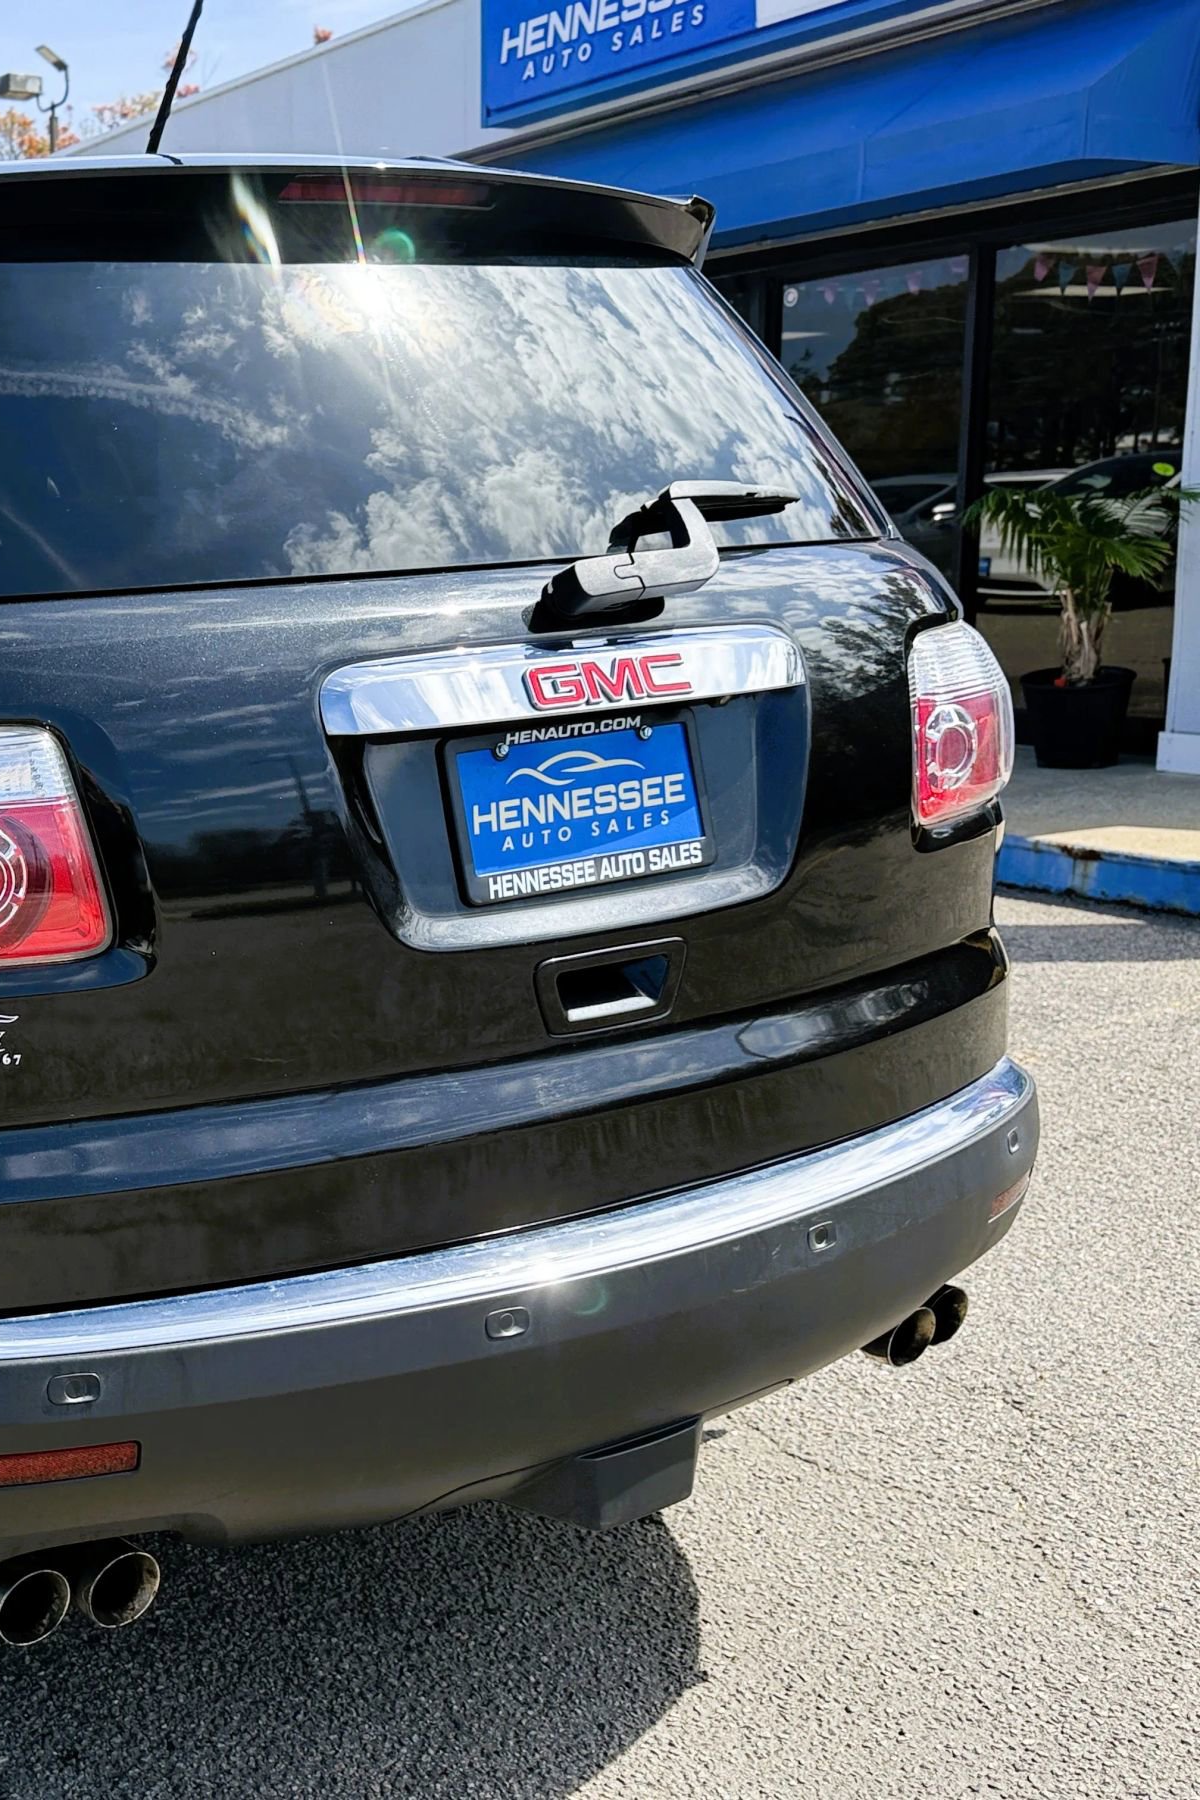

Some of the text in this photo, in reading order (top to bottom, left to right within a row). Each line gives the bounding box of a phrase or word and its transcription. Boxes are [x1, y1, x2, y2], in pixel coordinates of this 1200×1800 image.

[522, 4, 704, 81] AUTO SALES
[525, 653, 693, 709] GMC
[505, 715, 641, 745] HENAUTO.COM
[473, 773, 686, 835] HENNESSEE
[502, 809, 670, 851] AUTO SALES
[488, 842, 703, 900] HENNESSEE AUTO SALES
